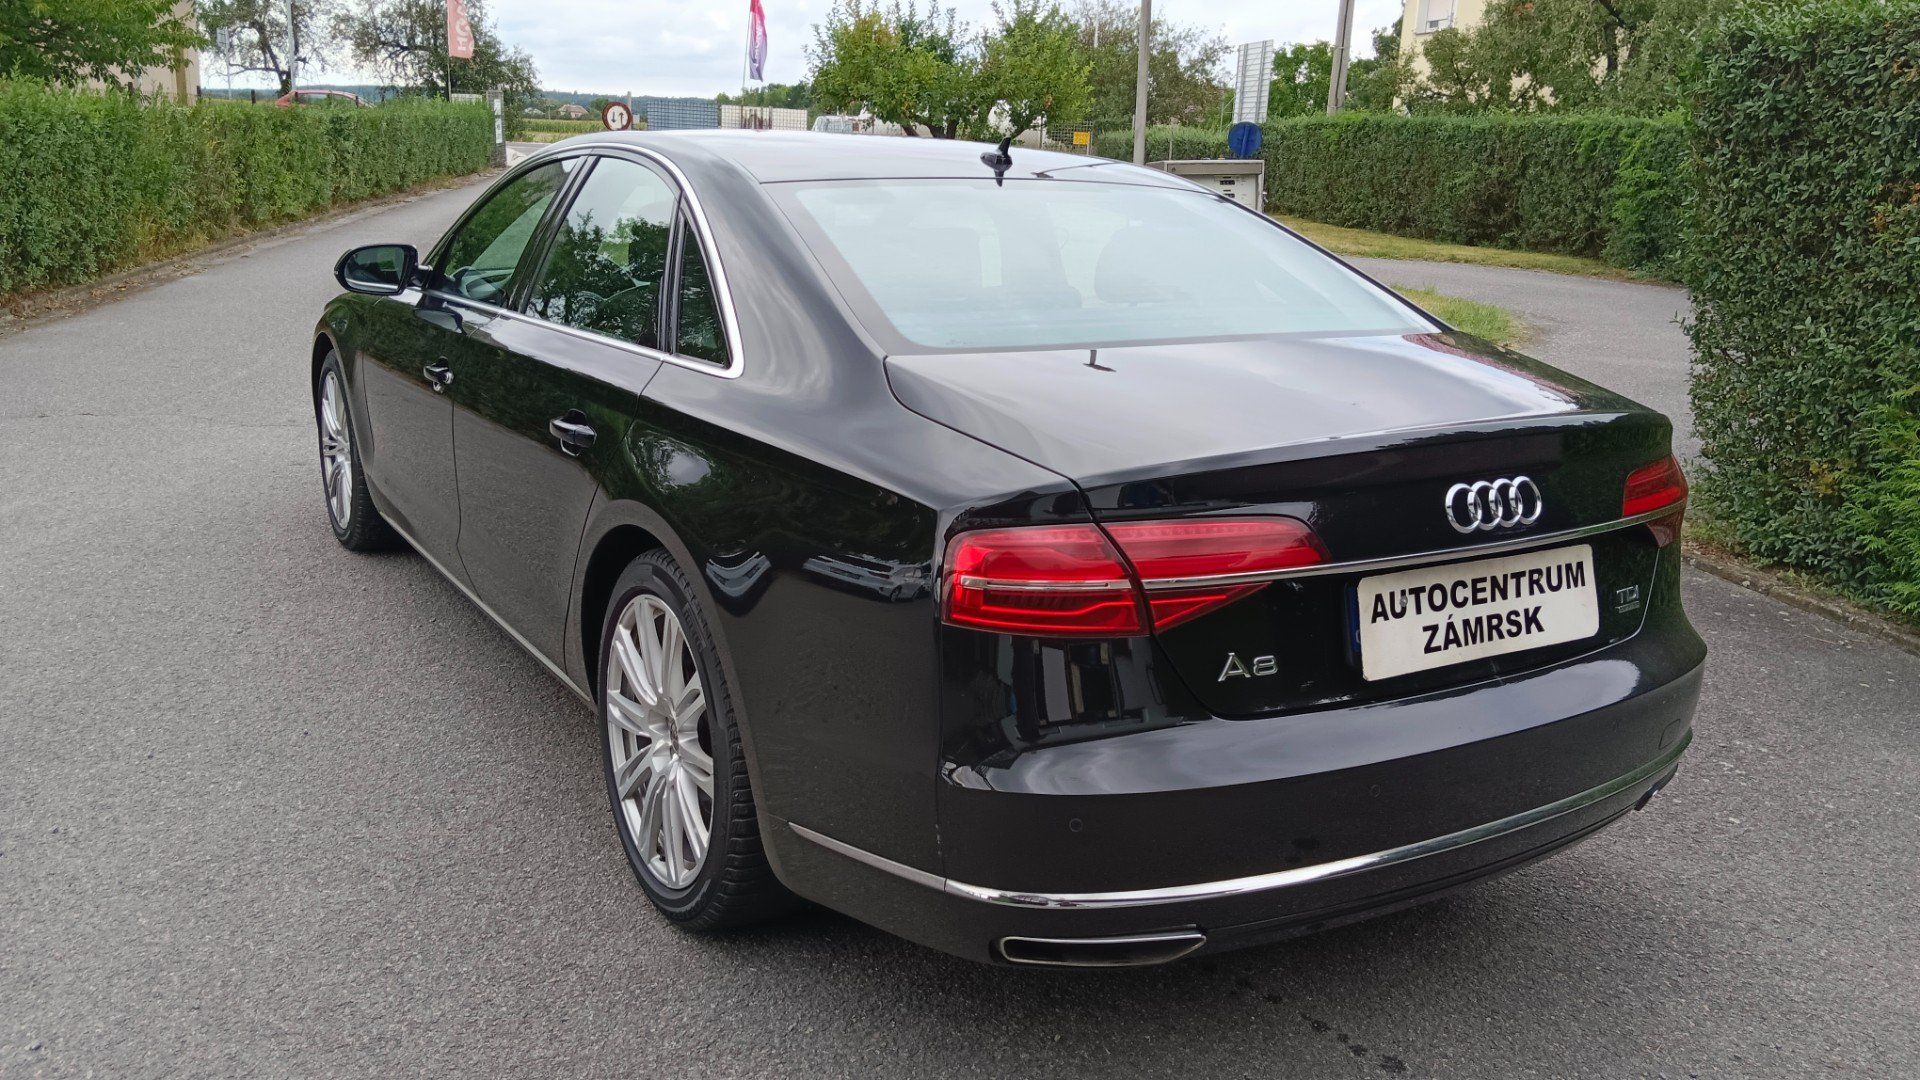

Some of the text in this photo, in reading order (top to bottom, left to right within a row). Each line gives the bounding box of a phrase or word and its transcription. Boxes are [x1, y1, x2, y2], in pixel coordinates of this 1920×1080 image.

[1371, 561, 1586, 624] AUTOCENTRUM
[1422, 606, 1545, 655] ZÁMRSK
[1217, 652, 1278, 682] A8
